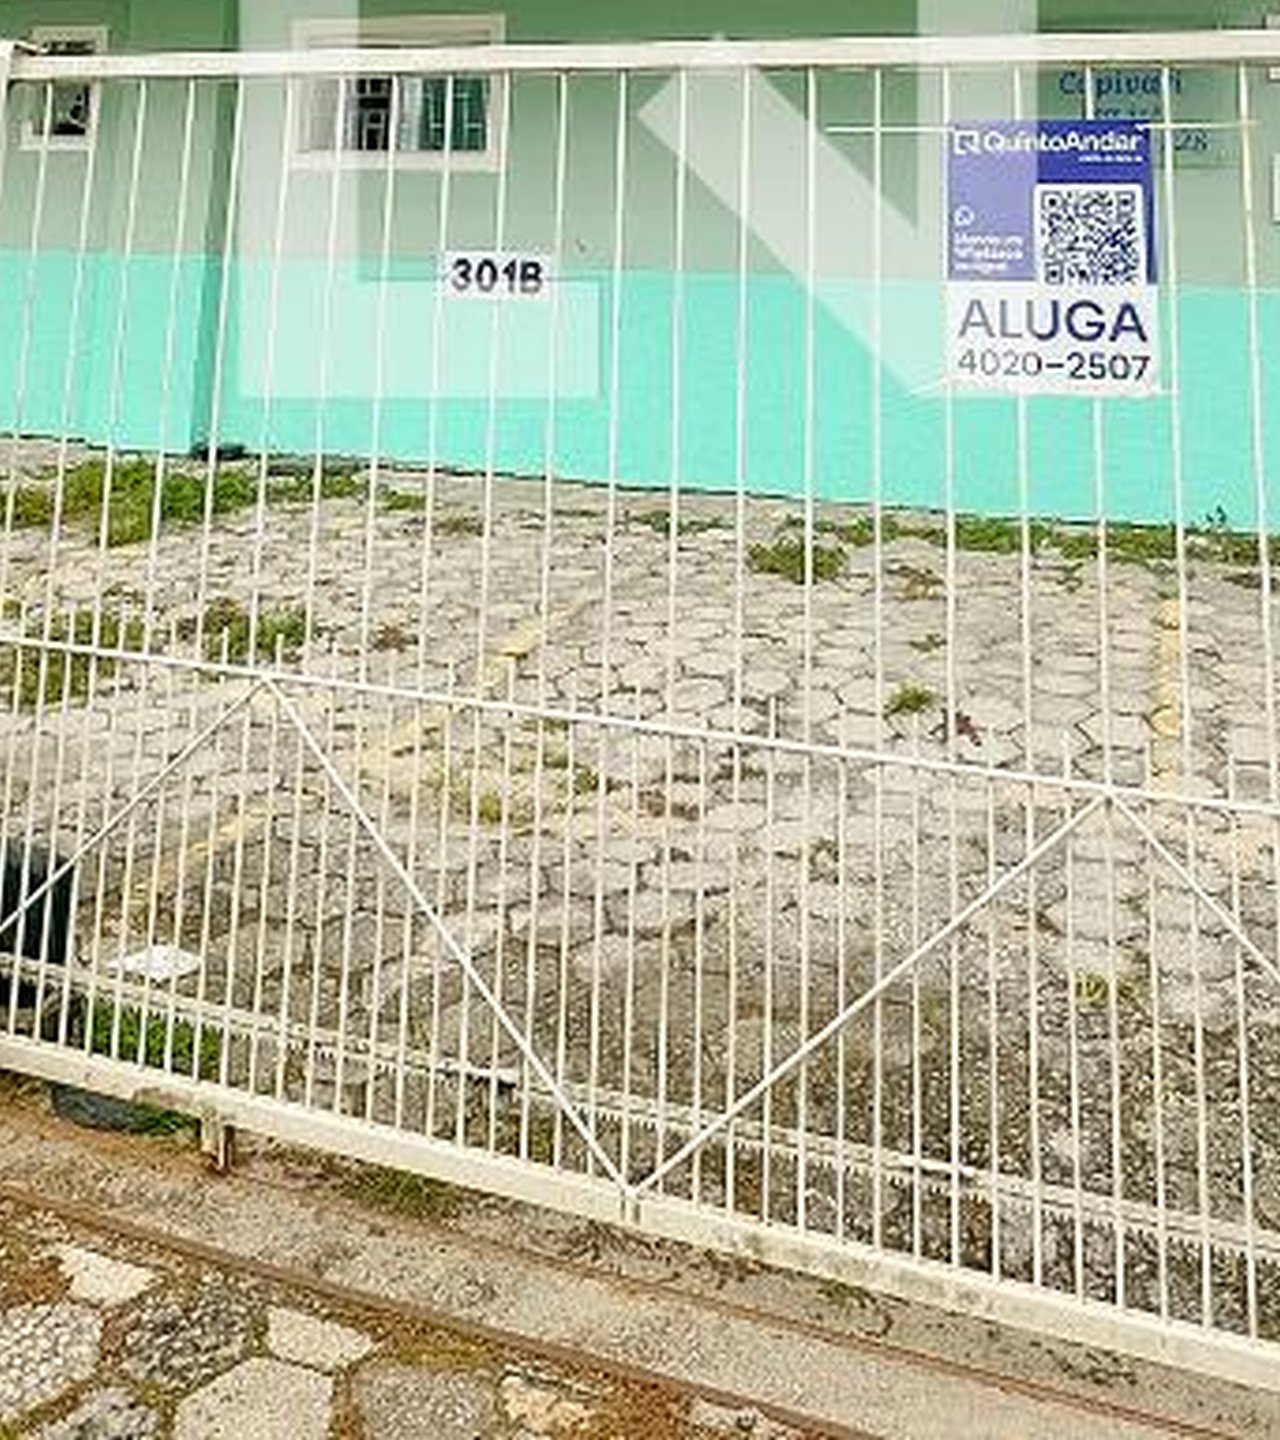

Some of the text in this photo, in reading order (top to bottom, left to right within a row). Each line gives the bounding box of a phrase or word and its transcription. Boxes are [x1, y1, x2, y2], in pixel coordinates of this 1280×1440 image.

[984, 131, 1141, 153] QuintoAndar
[451, 258, 542, 294] 301B
[958, 299, 1147, 342] ALUGA
[958, 348, 1151, 380] 4020-2507
